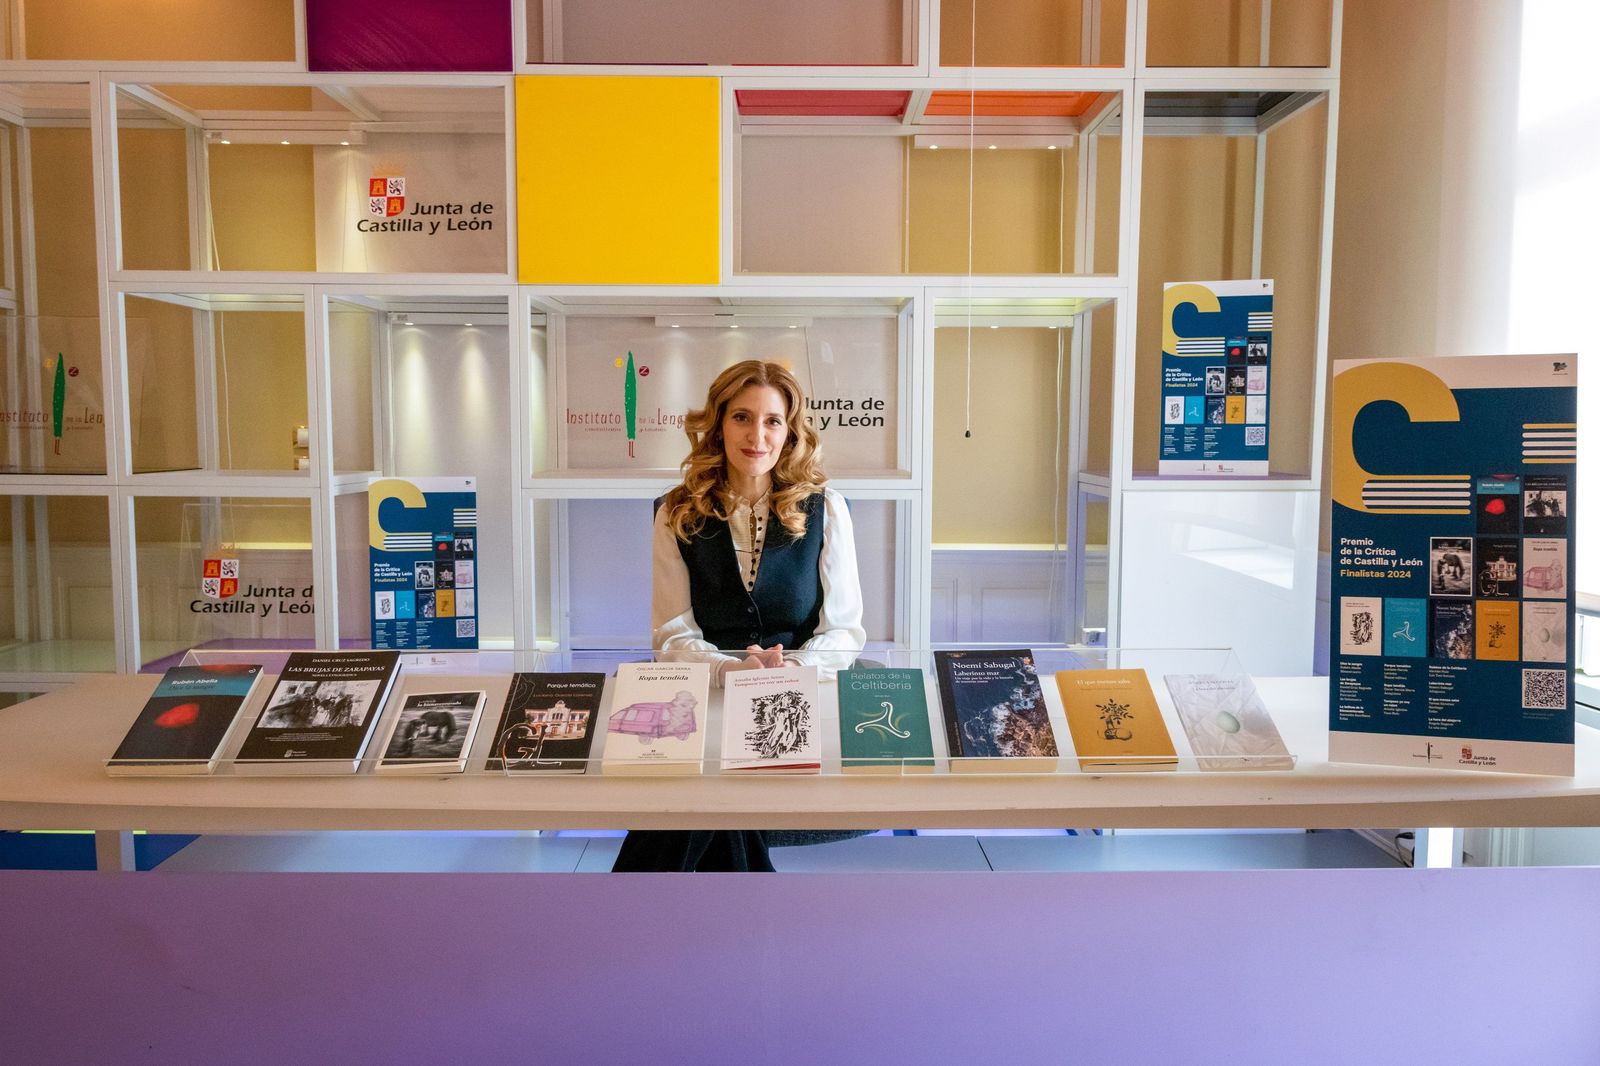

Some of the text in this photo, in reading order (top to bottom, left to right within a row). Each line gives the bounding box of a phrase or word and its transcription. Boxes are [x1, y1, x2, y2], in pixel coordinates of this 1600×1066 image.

[410, 201, 493, 215] Junta de
[357, 217, 492, 236] Castilla y León
[861, 397, 884, 410] de
[566, 408, 621, 424] Instituto
[820, 416, 831, 430] y
[838, 413, 884, 426] León
[1340, 538, 1373, 546] Premio
[1365, 548, 1396, 556] Crítica
[1354, 558, 1389, 566] Castilla
[1391, 559, 1397, 567] y
[1400, 558, 1423, 566] León
[243, 585, 295, 598] Junta
[190, 600, 255, 613] Castilla
[260, 604, 272, 617] y
[852, 681, 912, 690] Celtiberia
